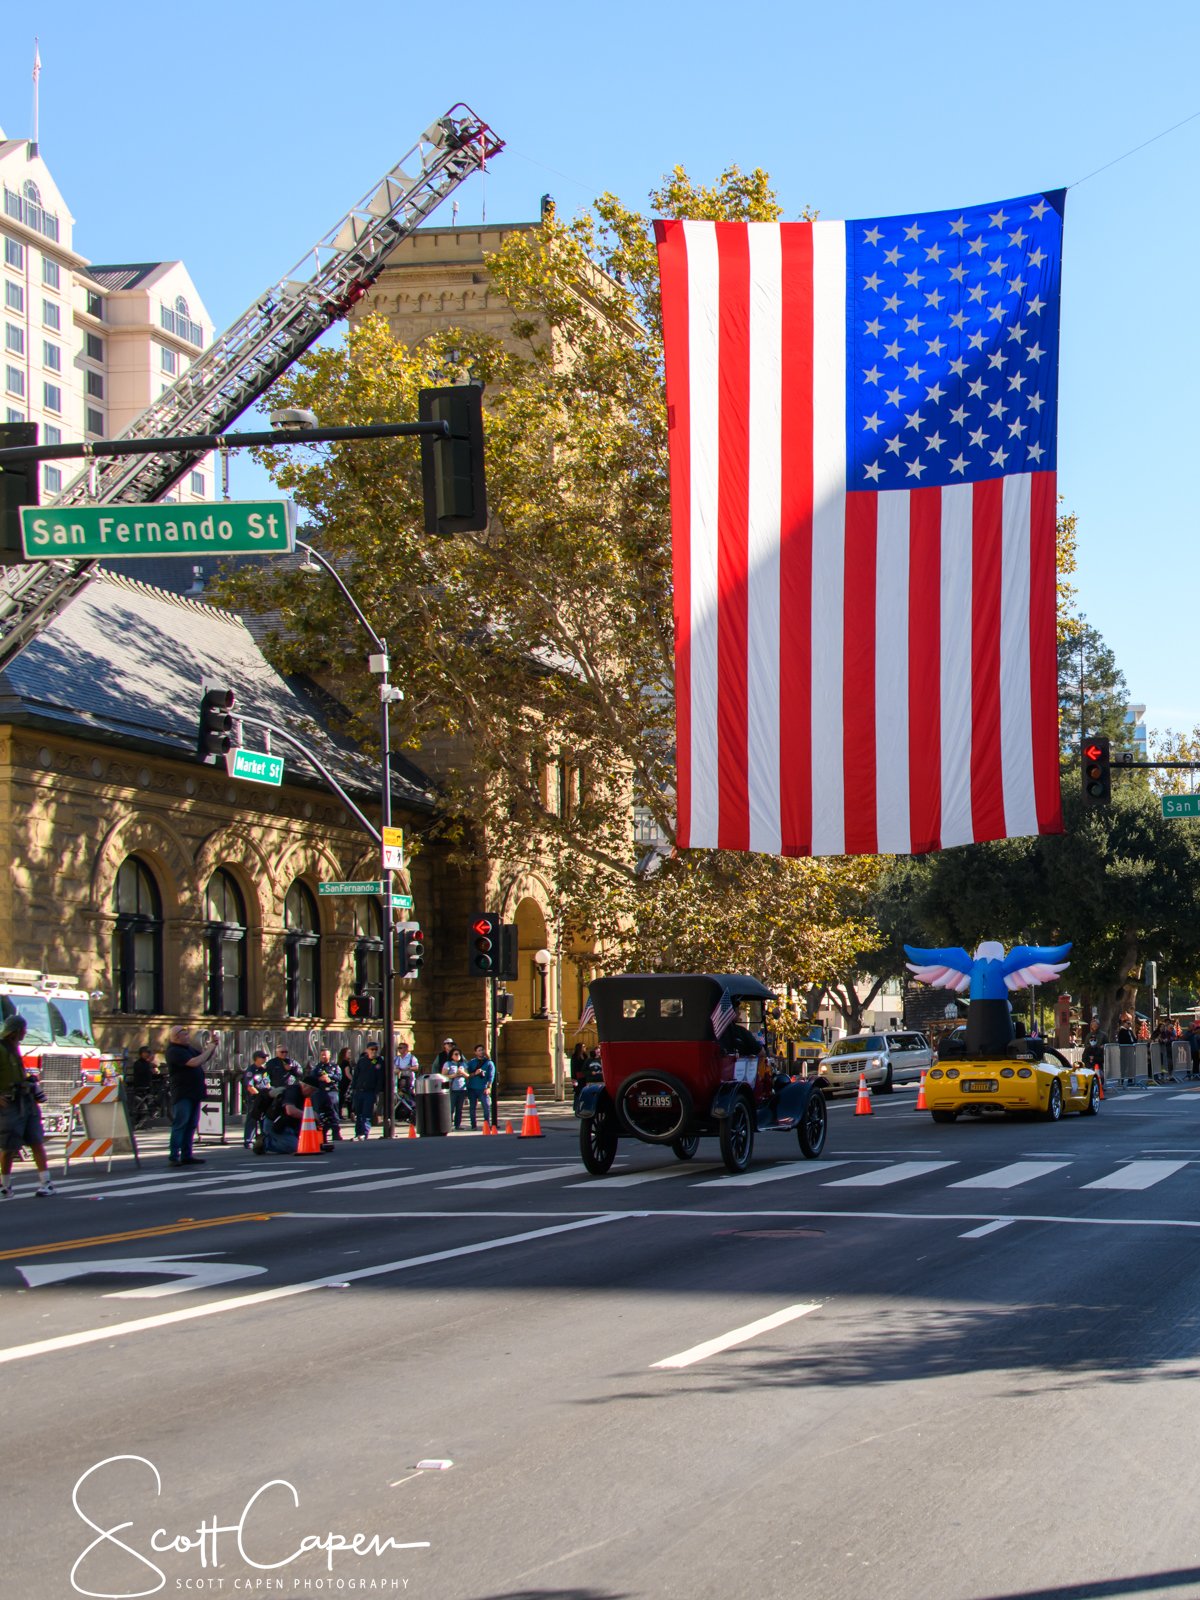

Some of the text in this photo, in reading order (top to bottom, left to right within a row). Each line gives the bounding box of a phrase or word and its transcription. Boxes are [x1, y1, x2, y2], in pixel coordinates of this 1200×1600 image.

[32, 513, 279, 545] San Fernando St
[236, 756, 280, 778] Market St
[1166, 801, 1191, 812] San
